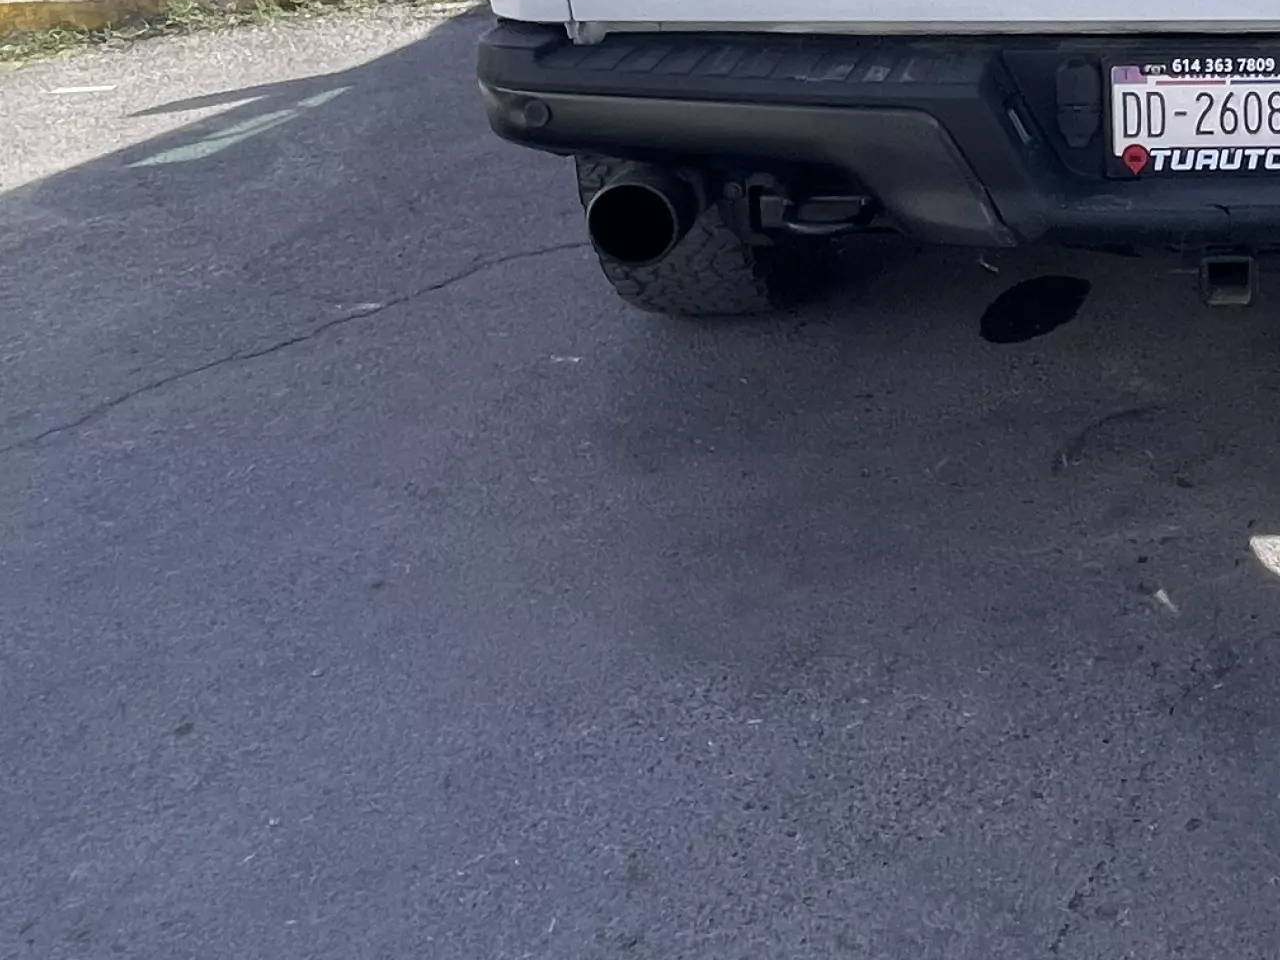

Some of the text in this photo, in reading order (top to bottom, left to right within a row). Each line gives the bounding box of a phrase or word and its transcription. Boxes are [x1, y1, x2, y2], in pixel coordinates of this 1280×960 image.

[1171, 58, 1276, 73] 614 363 7809
